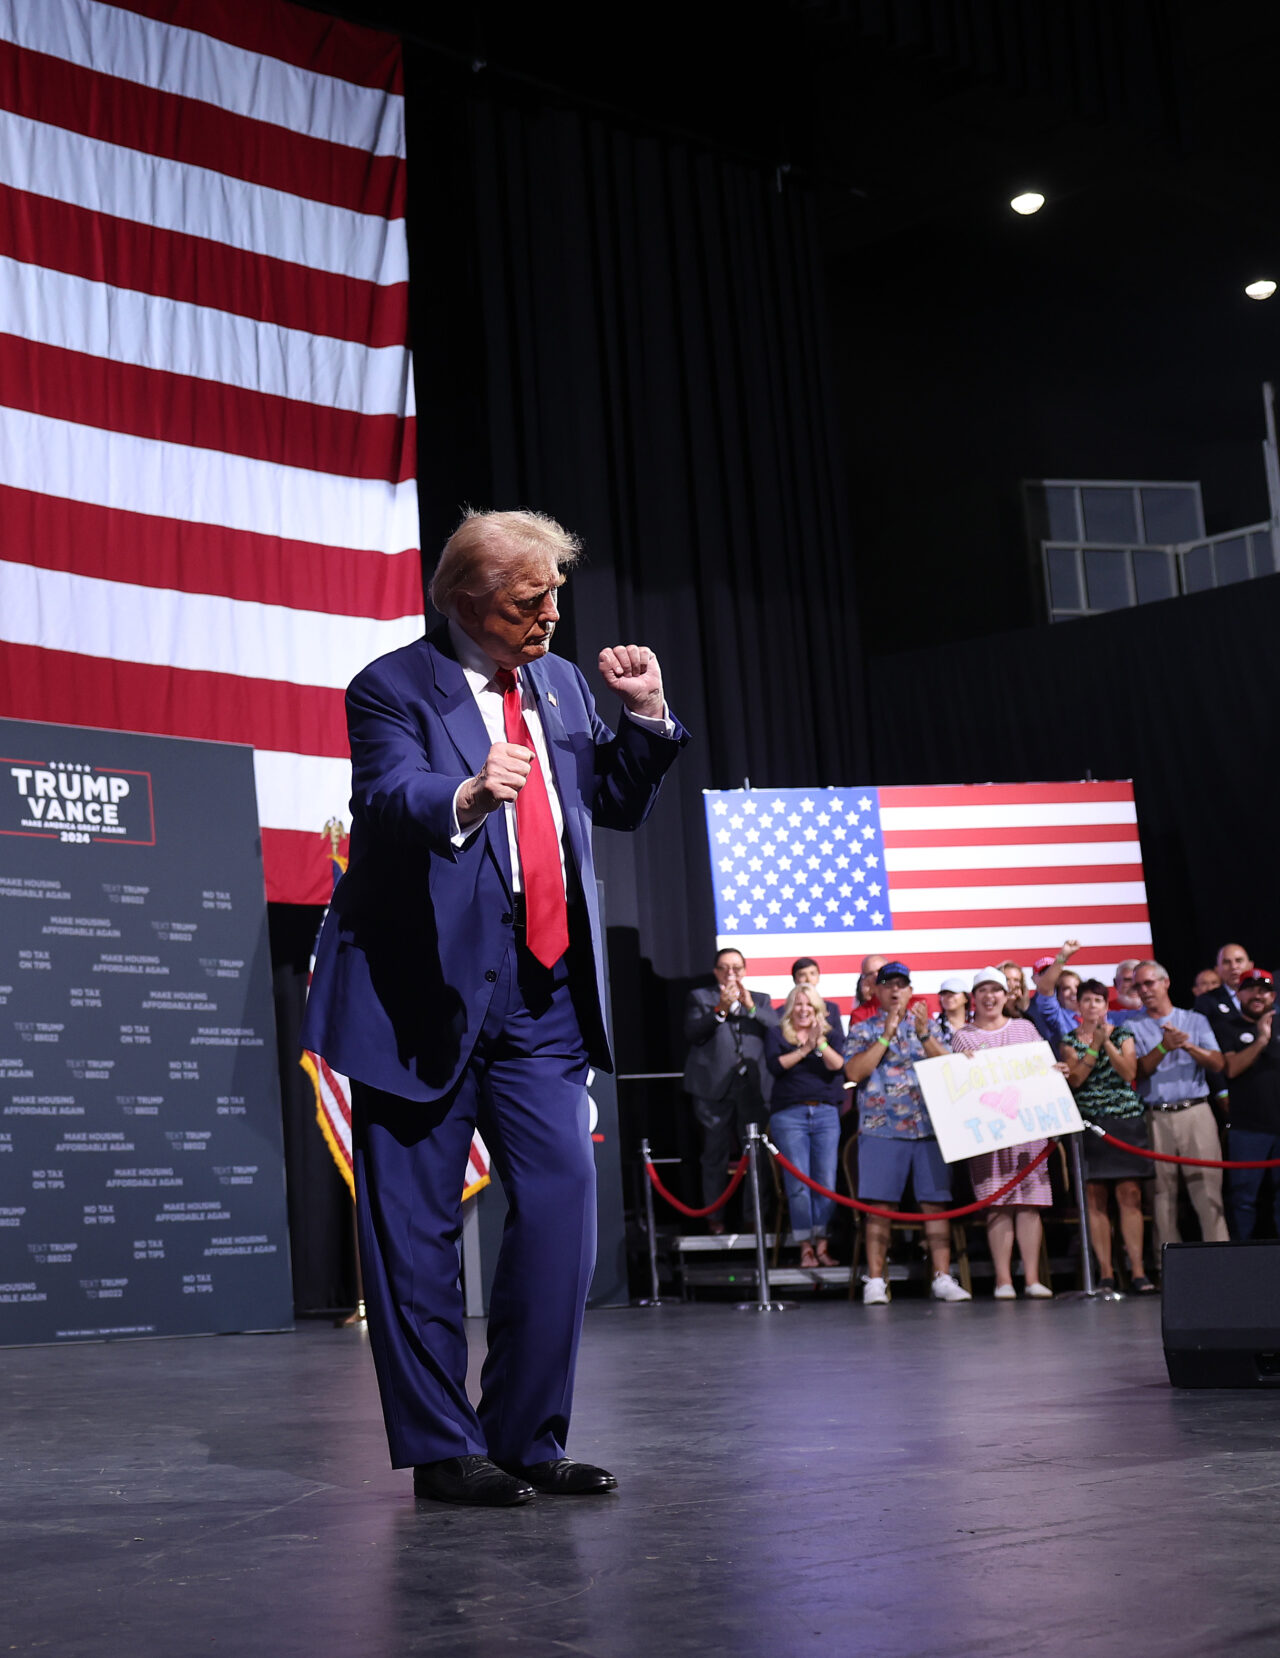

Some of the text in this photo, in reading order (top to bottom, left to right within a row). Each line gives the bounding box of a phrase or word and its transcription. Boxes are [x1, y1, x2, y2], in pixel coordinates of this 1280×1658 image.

[11, 767, 130, 803] TRUMP
[27, 797, 119, 825] VANCE
[60, 830, 90, 844] 2024
[24, 879, 61, 889] HOUSING
[46, 891, 71, 900] AGAIN
[202, 891, 230, 900] NO TAX
[202, 901, 232, 910] ON TIPS
[50, 917, 111, 927] MAKE HOUSING
[42, 926, 121, 938] AFFORDABLE AGAIN
[18, 951, 50, 959] NO TAX
[100, 955, 160, 964] MAKE HOUSING
[19, 961, 52, 970] ON TIPS
[92, 964, 170, 975] AFFORDABLE AGAIN
[70, 988, 100, 997] NO TAX
[174, 992, 208, 1000] HOUSING
[70, 999, 102, 1007] ON TIPS
[142, 1001, 218, 1011] AFFORDABLE AGAIN
[120, 1025, 150, 1034] NO TAX
[221, 1028, 254, 1036] HOUSING
[135, 1036, 152, 1044] TIPS
[190, 1037, 264, 1046] AFFORDABLE AGAIN
[8, 1070, 34, 1078] AGAIN
[12, 1096, 75, 1104] MAKE HOUSING
[4, 1107, 85, 1115] AFFORDABLE AGAIN
[964, 1097, 1072, 1144] TRUMP
[64, 1133, 125, 1141] MAKE HOUSING
[55, 1143, 135, 1152] AFFORDABLE AGAIN
[32, 1170, 64, 1178] NO TAX
[114, 1168, 174, 1177] MAKE HOUSING
[32, 1181, 65, 1189] ON TIPS
[106, 1179, 183, 1187] AFFORDABLE AGAIN
[84, 1205, 114, 1214] NO TAX
[163, 1202, 222, 1211] MAKE HOUSING
[84, 1216, 116, 1224] ON TIPS
[155, 1212, 231, 1222] AFFORDABLE AGAIN
[134, 1240, 163, 1249] NO TAX
[211, 1236, 268, 1245] MAKE HOUSING
[134, 1250, 165, 1259] ON TIPS
[204, 1246, 277, 1256] AFFORDABLE AGAIN
[182, 1274, 212, 1283] NO TAX
[182, 1285, 213, 1293] ON TIPS
[21, 1293, 47, 1302] AGAIN
